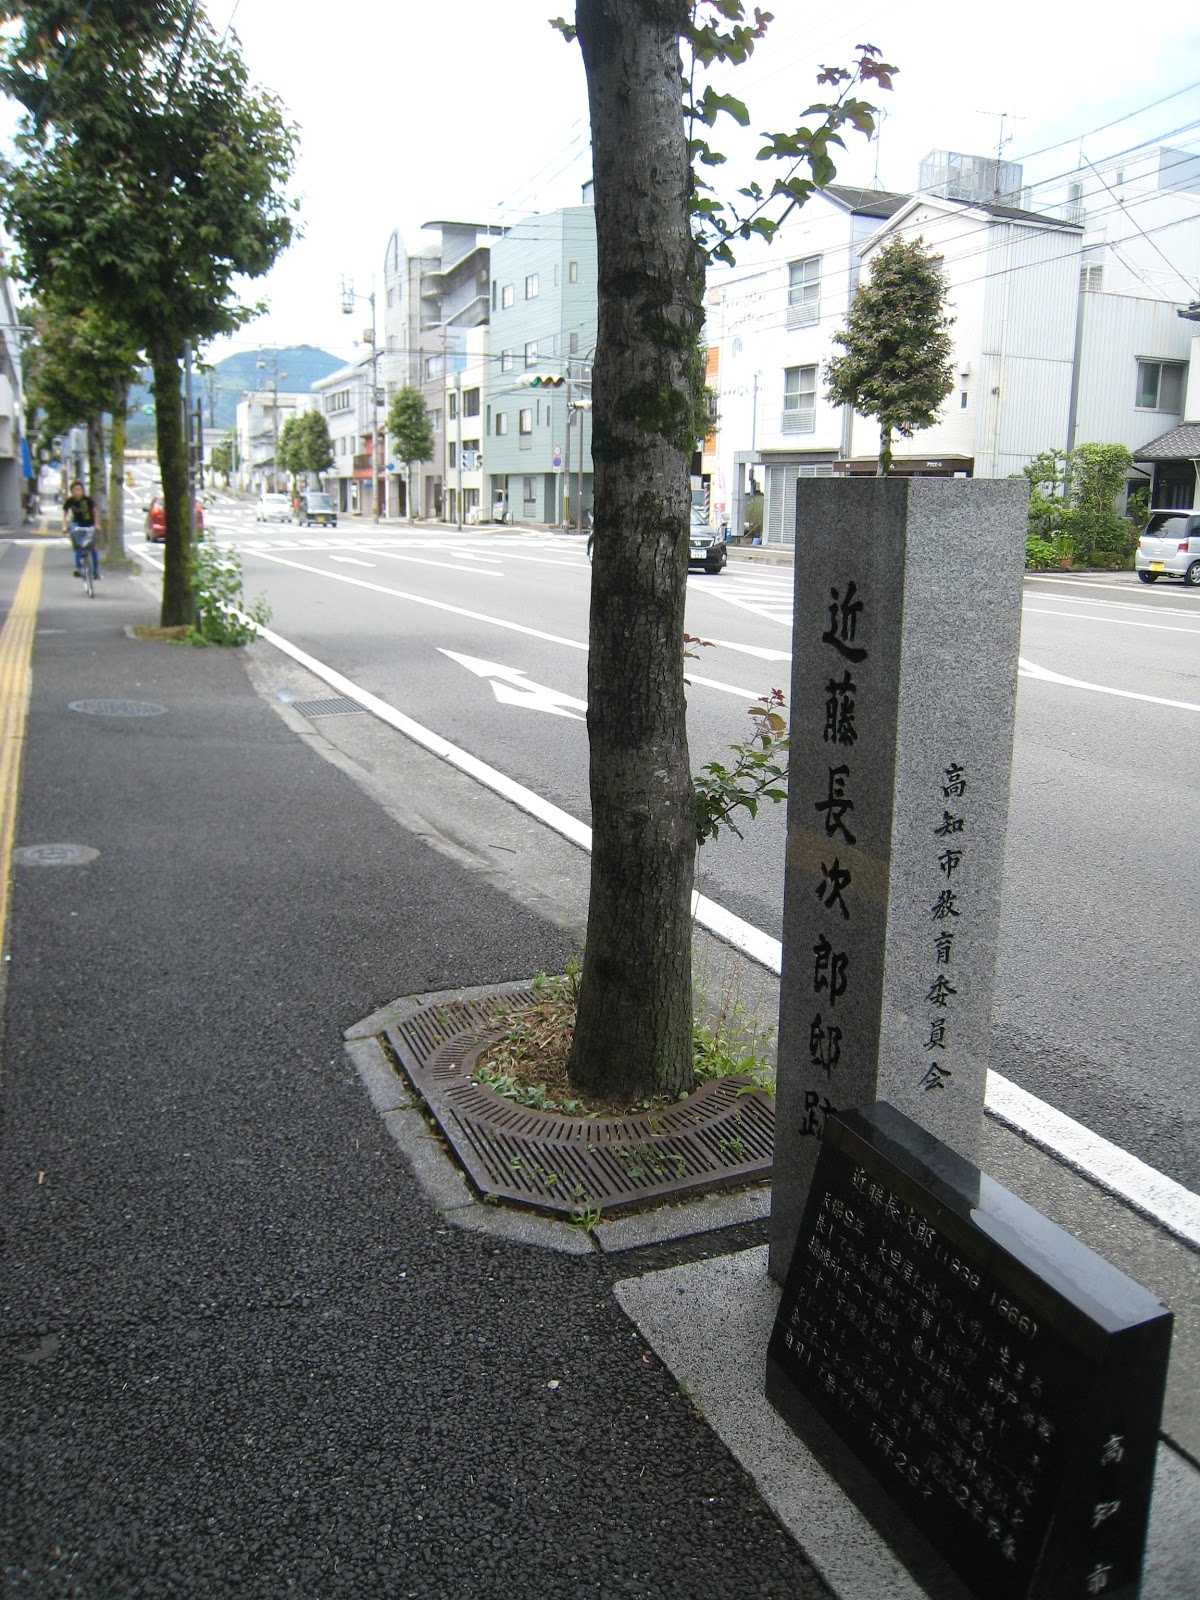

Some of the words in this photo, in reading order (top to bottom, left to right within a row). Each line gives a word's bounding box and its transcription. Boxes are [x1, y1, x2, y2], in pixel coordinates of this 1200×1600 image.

[918, 762, 967, 1092] 高知市教育委員会
